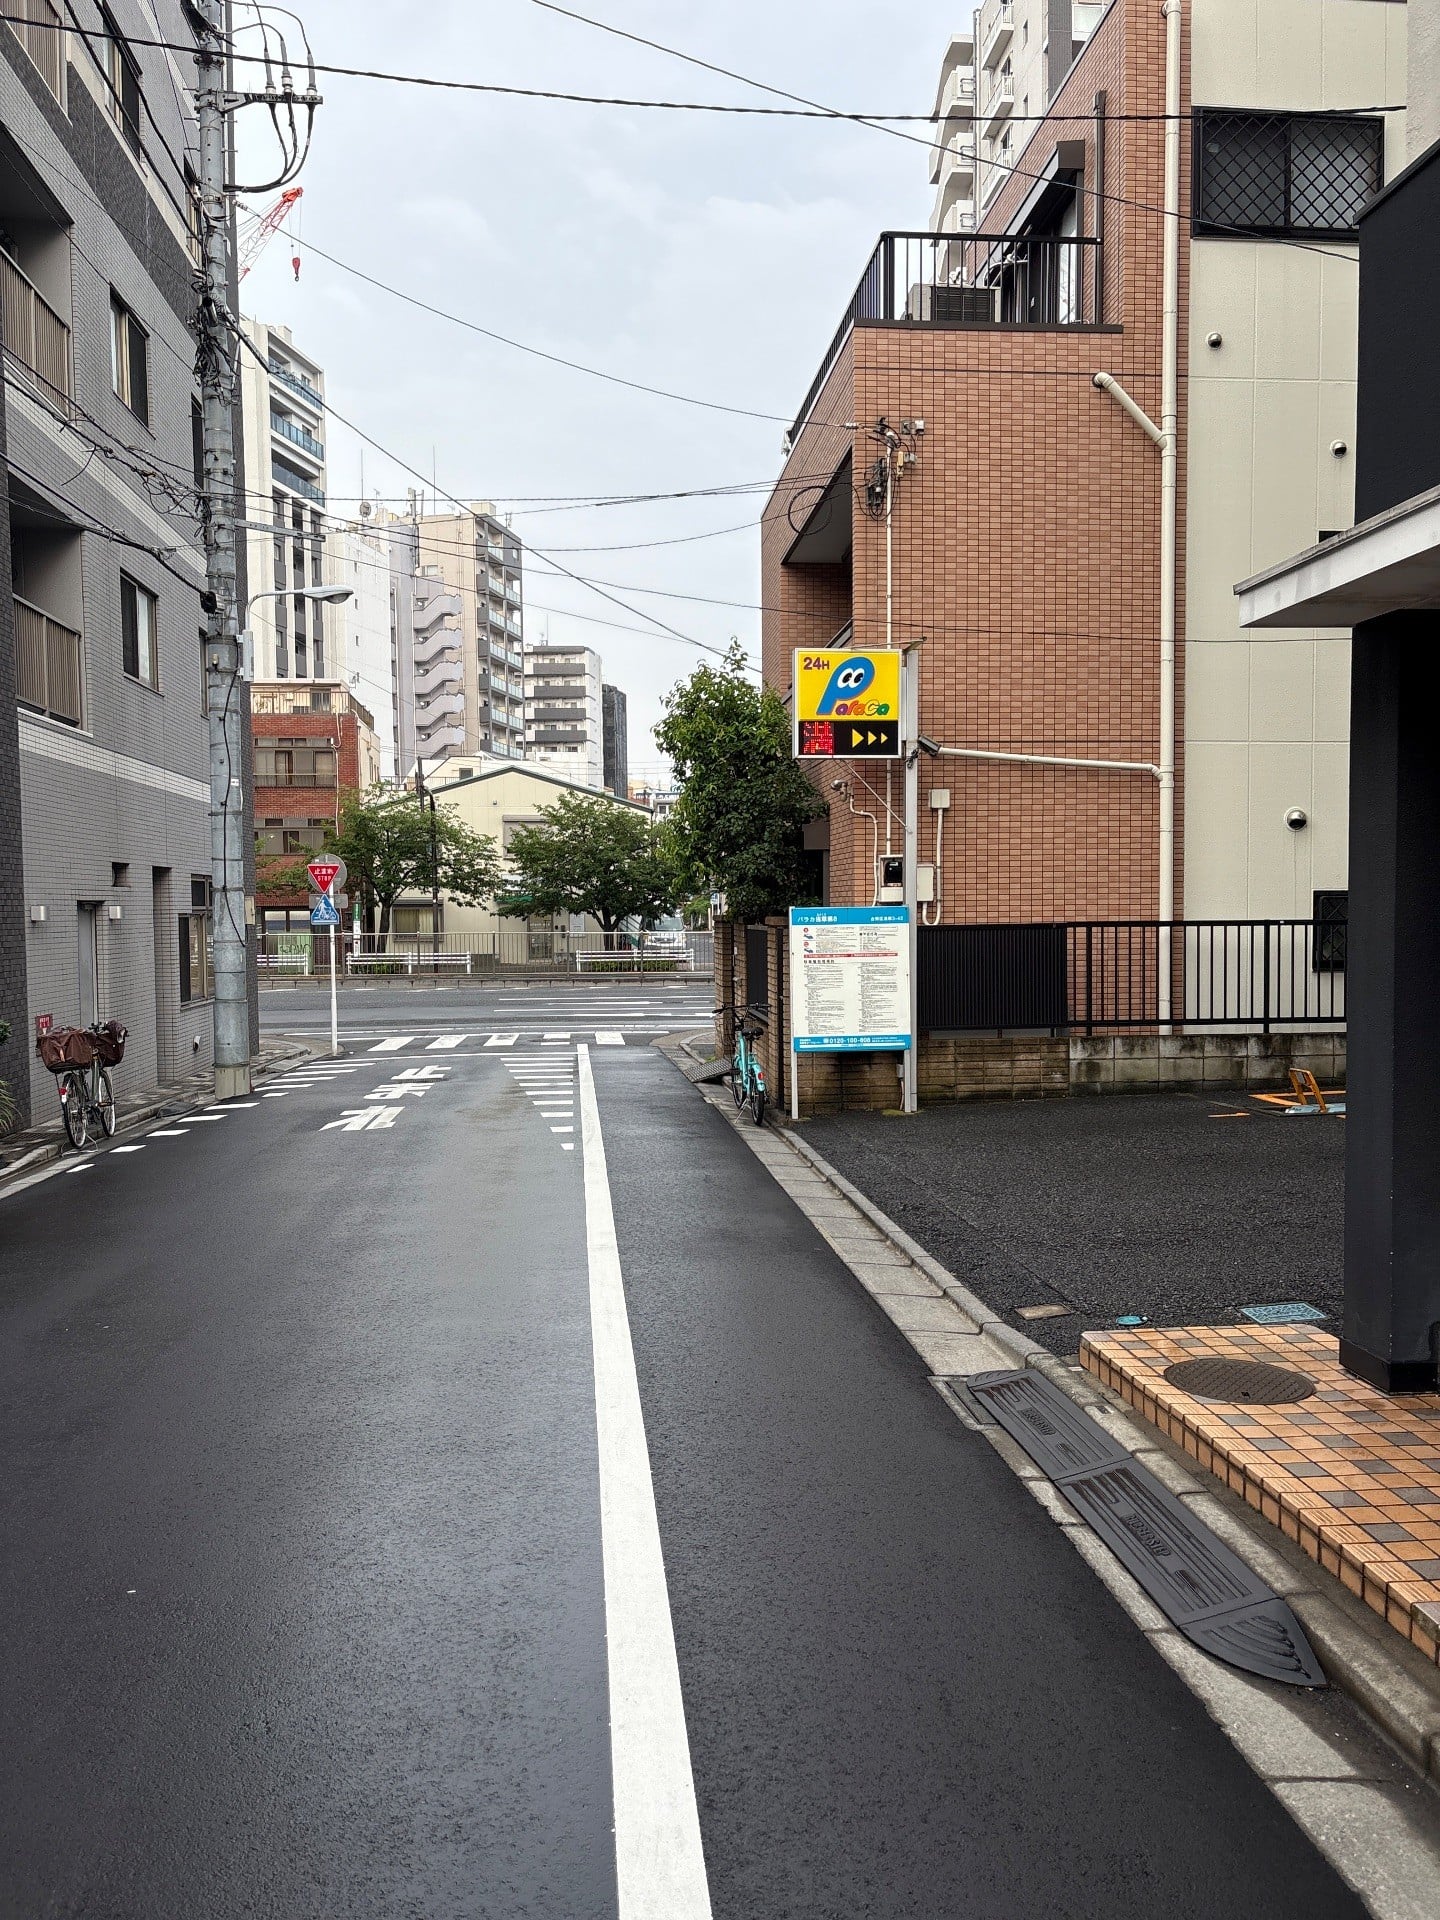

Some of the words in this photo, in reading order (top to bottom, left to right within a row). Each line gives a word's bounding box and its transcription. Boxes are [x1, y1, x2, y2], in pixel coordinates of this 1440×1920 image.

[803, 656, 830, 671] 24H
[318, 1065, 452, 1132] 止まれ
